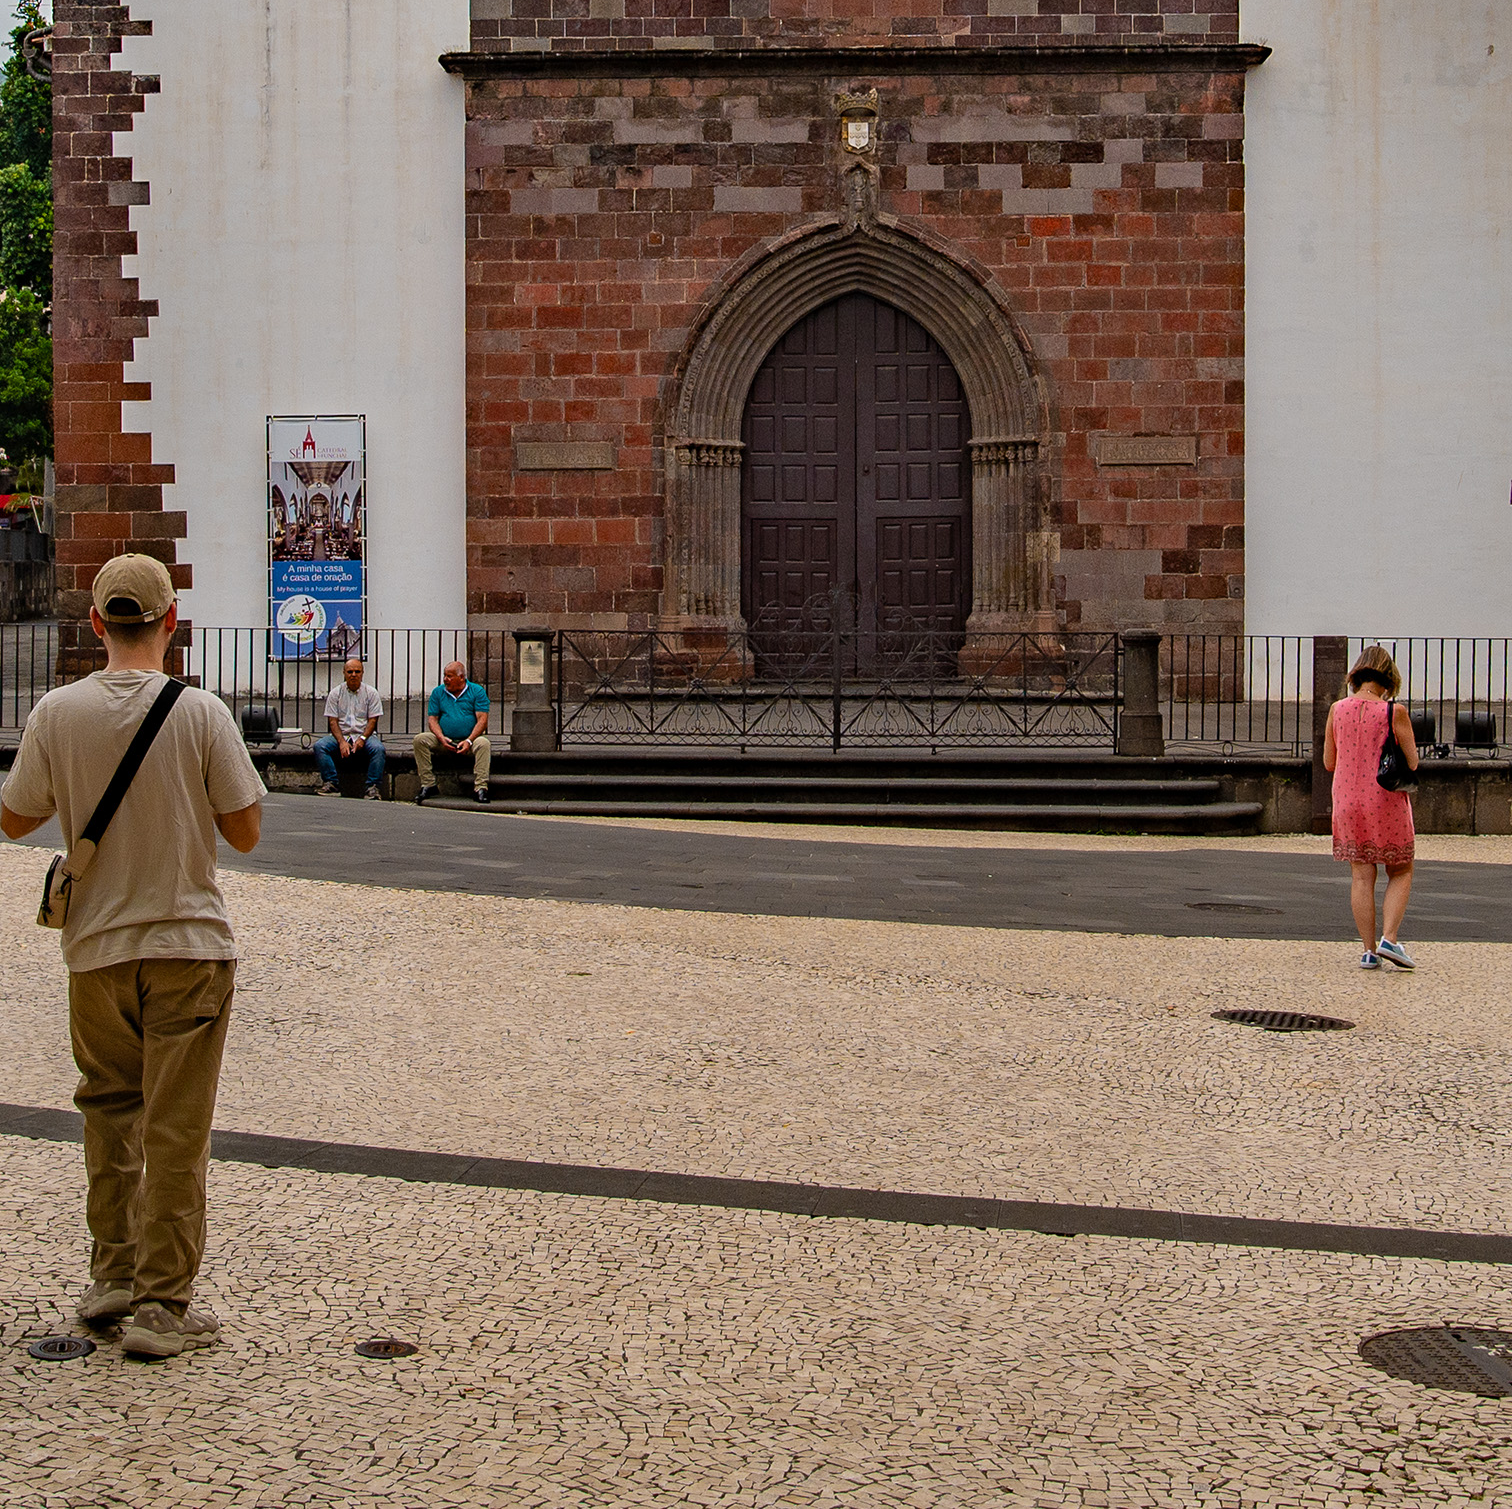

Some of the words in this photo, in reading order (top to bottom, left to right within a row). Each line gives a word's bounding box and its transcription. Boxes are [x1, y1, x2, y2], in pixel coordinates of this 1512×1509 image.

[288, 564, 296, 573] A
[296, 564, 322, 573] minha
[323, 565, 344, 573] casa
[282, 573, 288, 582] é
[311, 573, 323, 582] de
[323, 572, 353, 583] oração
